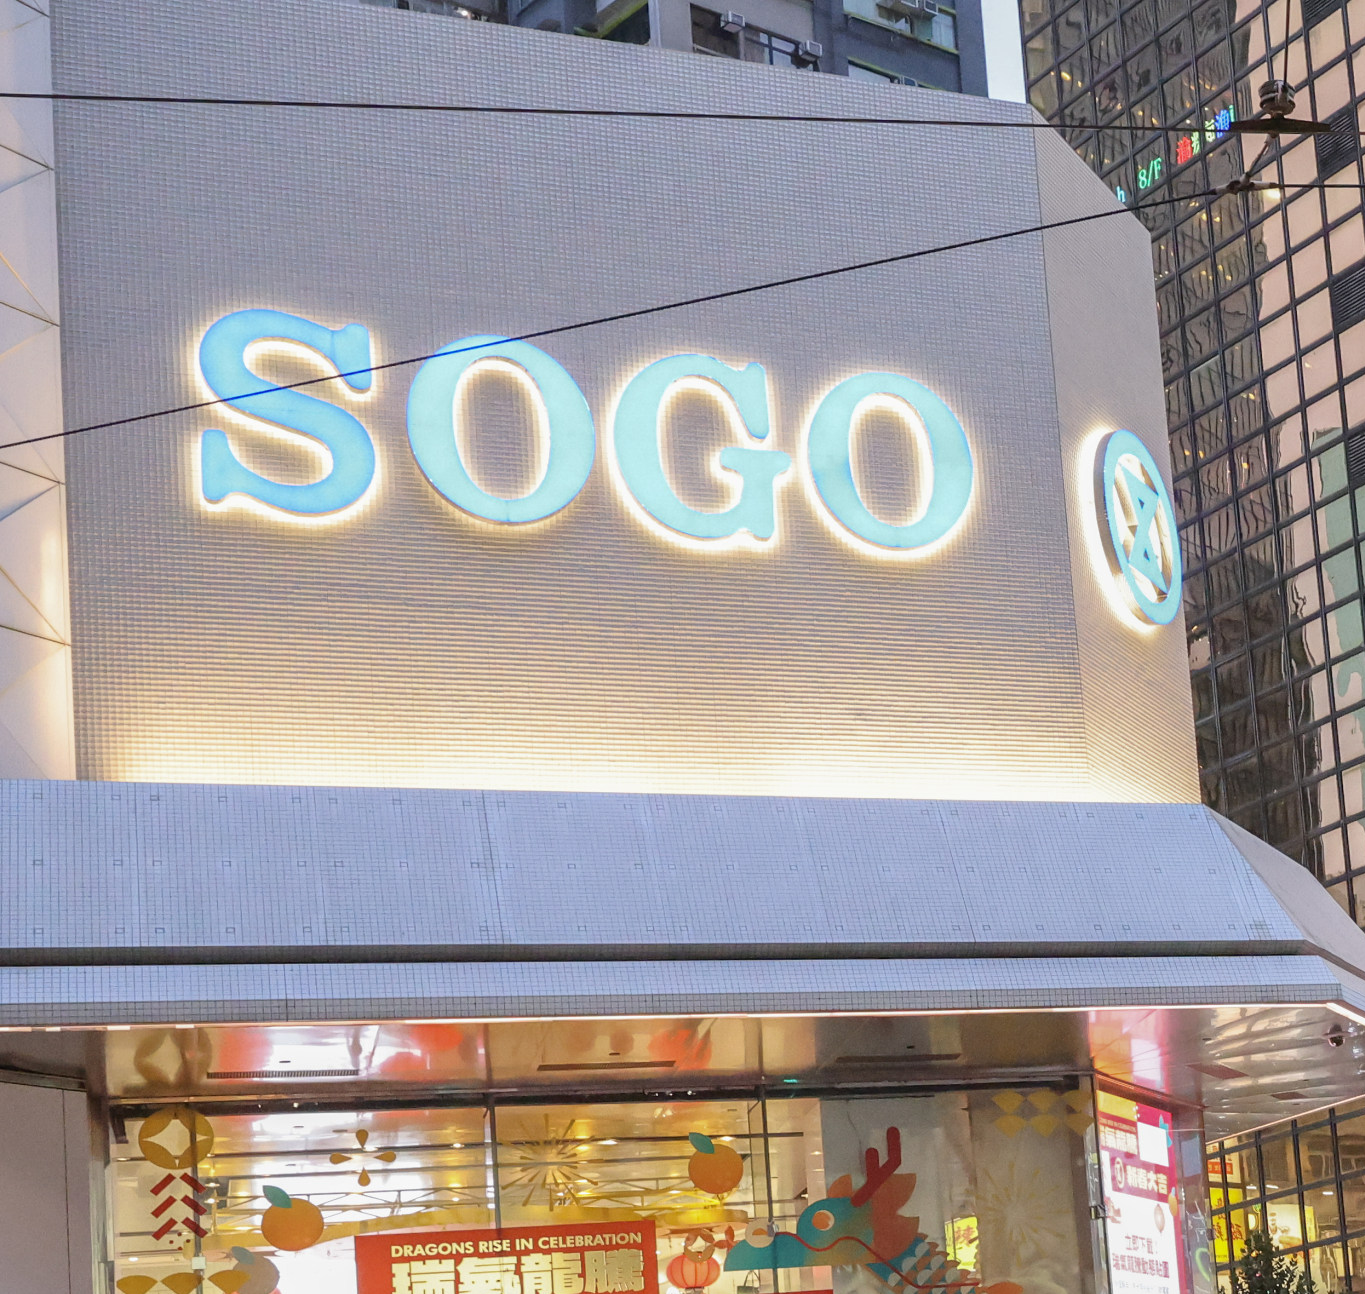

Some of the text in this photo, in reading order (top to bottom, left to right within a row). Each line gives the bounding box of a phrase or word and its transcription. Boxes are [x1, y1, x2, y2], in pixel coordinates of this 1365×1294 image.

[199, 308, 975, 552] SOGO
[1126, 1165, 1168, 1195] 新春大吉
[391, 1232, 642, 1258] DRAGONS RISE IN CELEBRATION
